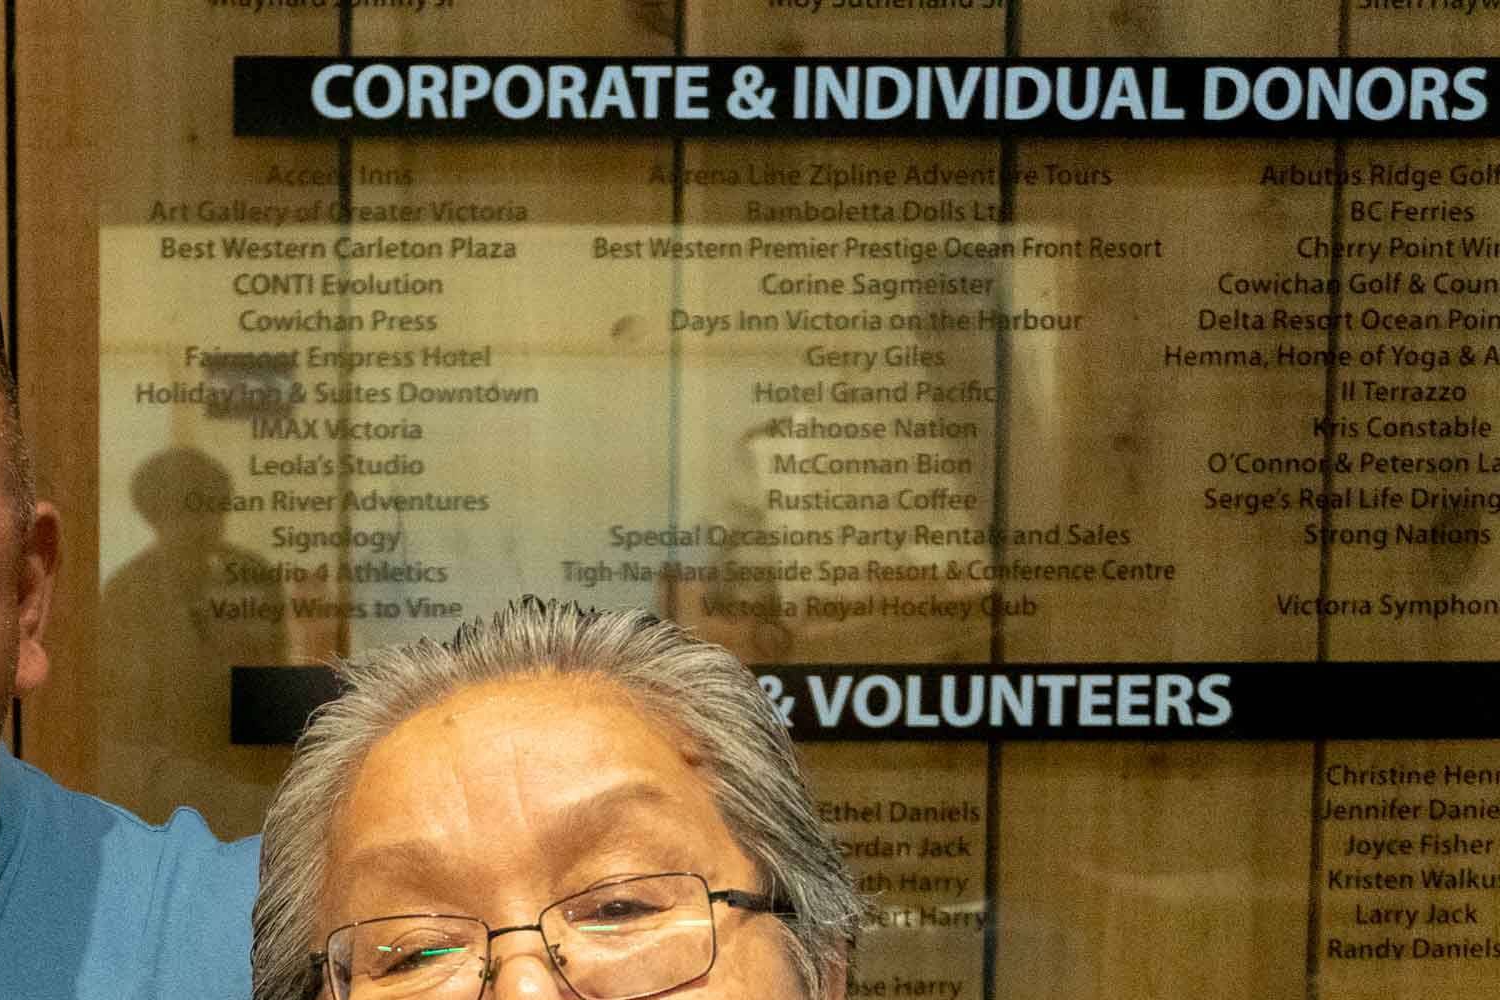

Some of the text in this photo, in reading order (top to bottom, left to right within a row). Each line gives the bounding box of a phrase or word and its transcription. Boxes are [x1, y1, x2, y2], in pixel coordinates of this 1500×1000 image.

[310, 64, 1488, 121] CORPORATE & INDIVIDUAL DONORS
[808, 163, 1113, 191] Zipline Tours
[1371, 164, 1442, 191] Ridge
[149, 200, 528, 227] Art Gallery Victoria
[903, 200, 965, 223] Dolls
[1351, 201, 1474, 222] BC Ferries
[161, 236, 516, 260] Best Western Carleton Plaza
[593, 236, 1163, 264] Best Western Premier Prestige Ocean Front Resort
[1298, 237, 1455, 263] Cherry Point
[233, 272, 444, 296] CONTI Evolution
[761, 273, 994, 300] Corine Sagmeister
[1219, 273, 1339, 295] Cowichan
[1349, 272, 1402, 295] Golf
[239, 309, 437, 333] Cowichan Press
[669, 309, 731, 336] Days
[739, 309, 778, 332] Inn
[786, 308, 882, 332] Victoria
[977, 309, 1082, 332] Harbour
[1200, 309, 1439, 331] Delta Resort Ocean
[307, 345, 491, 374] Empress Hotel
[806, 345, 946, 373] Gerry Giles
[1164, 345, 1450, 372] Hemma, Home of Yoga
[315, 382, 539, 405] Suites Downtown
[754, 380, 998, 403] Hotel Grand Pacific
[1363, 381, 1467, 402] Terrazzo
[251, 418, 423, 441] IMAX Victoria
[895, 417, 977, 440] Nation
[1313, 416, 1491, 438] Kris Constable
[250, 454, 424, 477] Leola's Studio
[774, 453, 971, 476] McConnan Bion
[1360, 451, 1468, 473] Peterson
[271, 490, 490, 512] River Adventures
[767, 488, 977, 511] Rusticana Coffee
[1205, 487, 1290, 514] Serge's
[1299, 488, 1353, 509] Real
[1359, 487, 1404, 509] Life
[272, 527, 401, 554] Signology
[610, 524, 699, 549] Special
[841, 524, 906, 550] Party
[1014, 524, 1058, 545] and
[1067, 524, 1131, 545] Sales
[1304, 524, 1491, 549] Strong Nations
[819, 560, 861, 586] Spa
[867, 560, 938, 581] Resort
[946, 560, 963, 581] &
[968, 559, 1095, 581] Conference
[1102, 559, 1176, 581] Centre
[406, 597, 462, 620] Vine
[882, 595, 973, 621] Hockey
[1277, 594, 1371, 616] Victoria
[807, 674, 1232, 729] VOLUNTEERS
[1326, 765, 1437, 786] Christine
[817, 801, 981, 824] Ethel Daniels
[1321, 799, 1421, 820] Jennifer
[917, 836, 972, 858] Jack
[1344, 834, 1494, 859] Joyce Fisher
[901, 875, 969, 898] Harry
[1328, 869, 1413, 890] Kristen
[1355, 904, 1478, 929] Larry Jack
[1327, 938, 1404, 962] Randy
[894, 977, 963, 999] Harry
